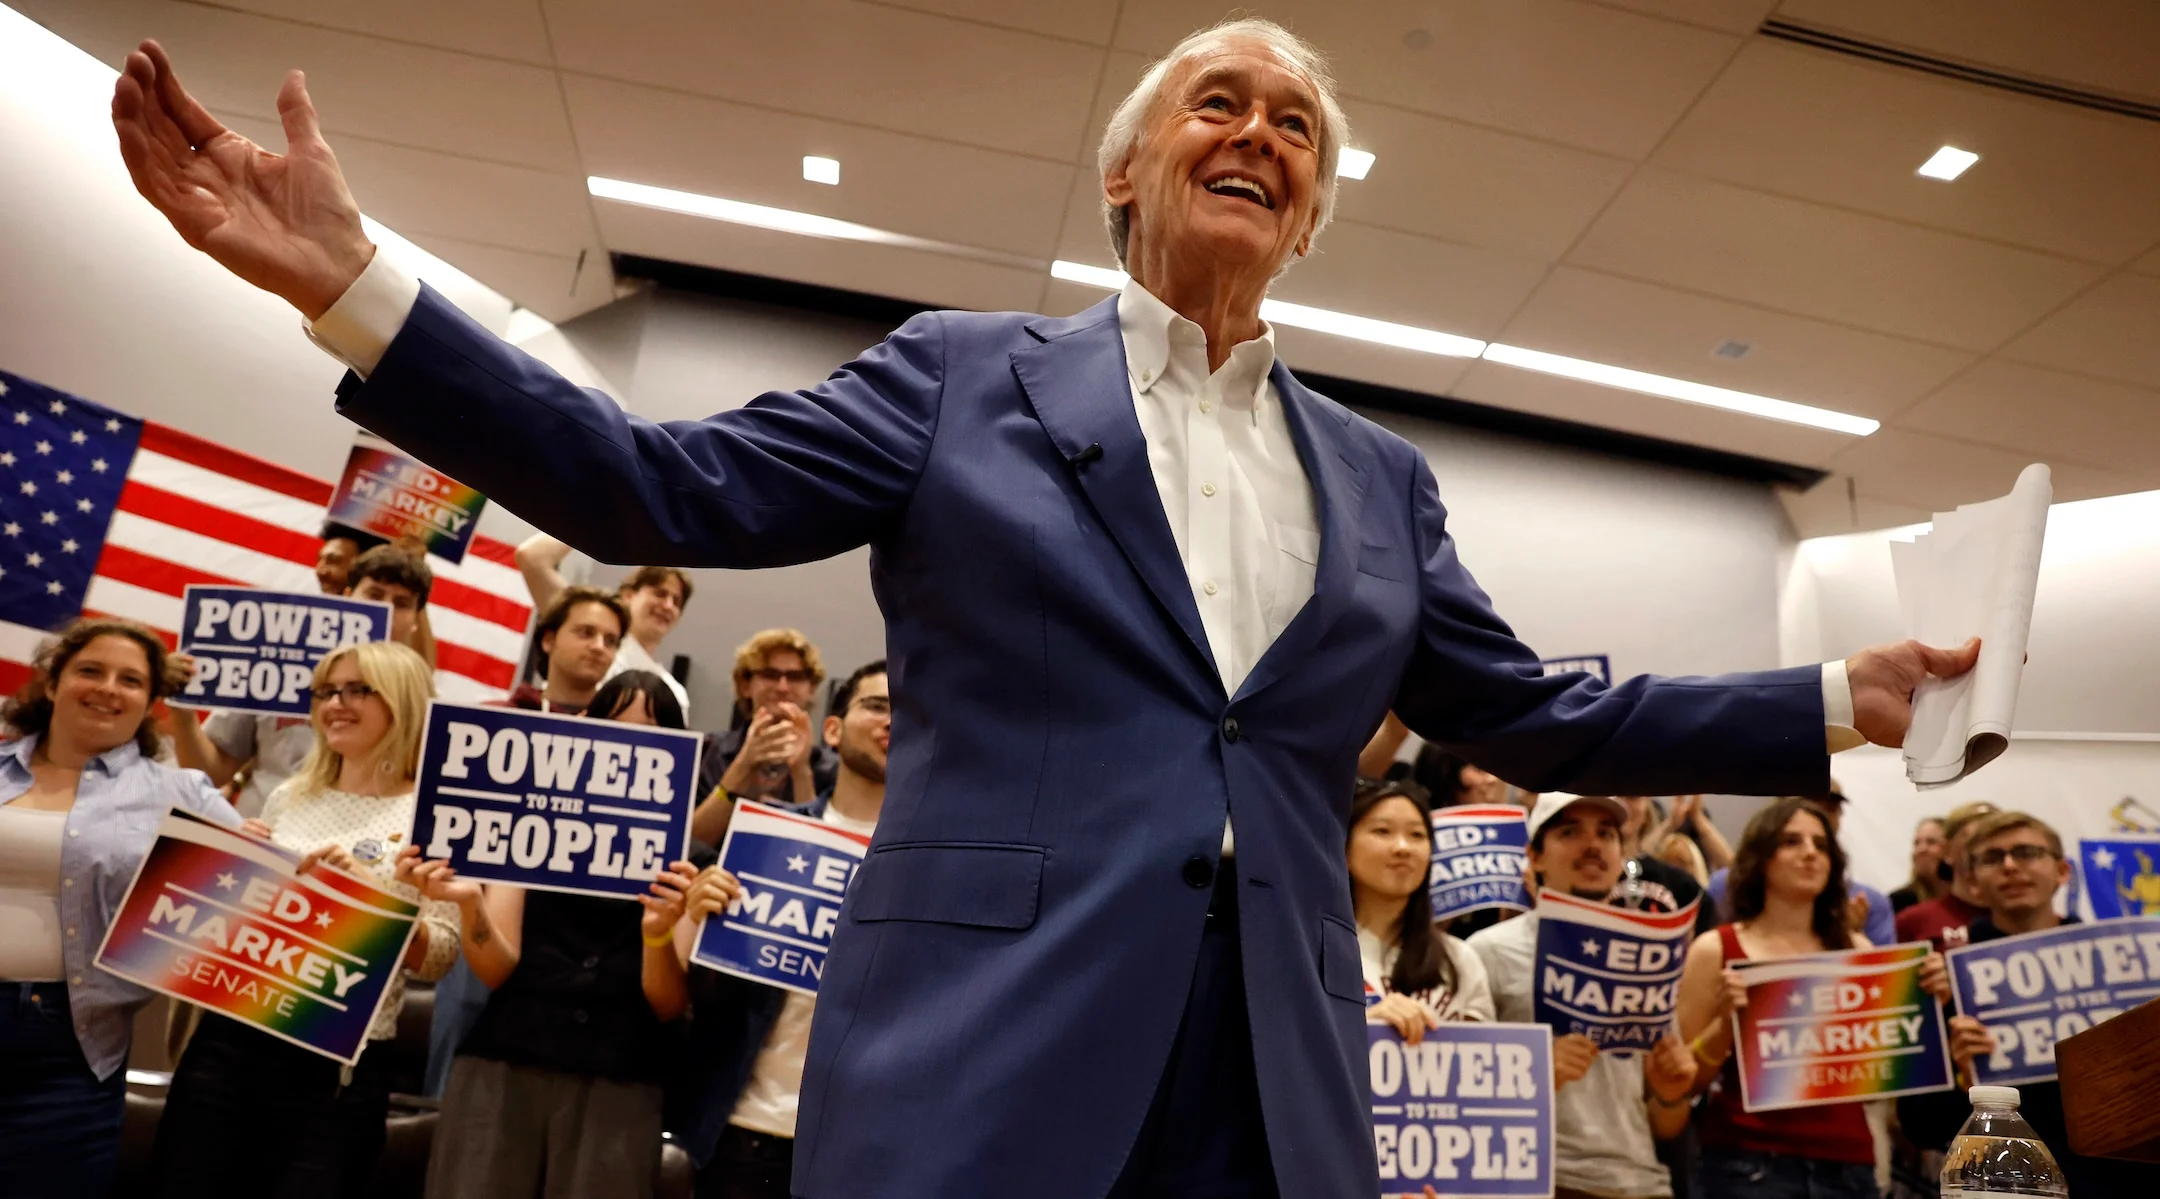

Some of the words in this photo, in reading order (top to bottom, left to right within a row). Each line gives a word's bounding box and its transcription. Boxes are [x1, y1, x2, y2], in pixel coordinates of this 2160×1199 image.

[399, 463, 439, 493] ED
[352, 476, 469, 533] MARKEY
[194, 598, 373, 650] POWER
[260, 646, 278, 660] TO
[279, 648, 305, 662] THE
[441, 721, 675, 804] POWER
[526, 793, 548, 811] TO
[550, 796, 584, 814] THE
[426, 804, 667, 882] PEOPLE
[1434, 826, 1483, 851] ED
[812, 855, 860, 893] E
[240, 876, 311, 923] ED
[148, 894, 367, 998] MARKEY
[1606, 938, 1671, 972] ED
[171, 955, 299, 1018] SENATE
[1811, 982, 1866, 1013] ED
[1757, 1015, 1924, 1059] MARKEY
[1405, 1103, 1425, 1119] TO
[1426, 1103, 1459, 1120] THE
